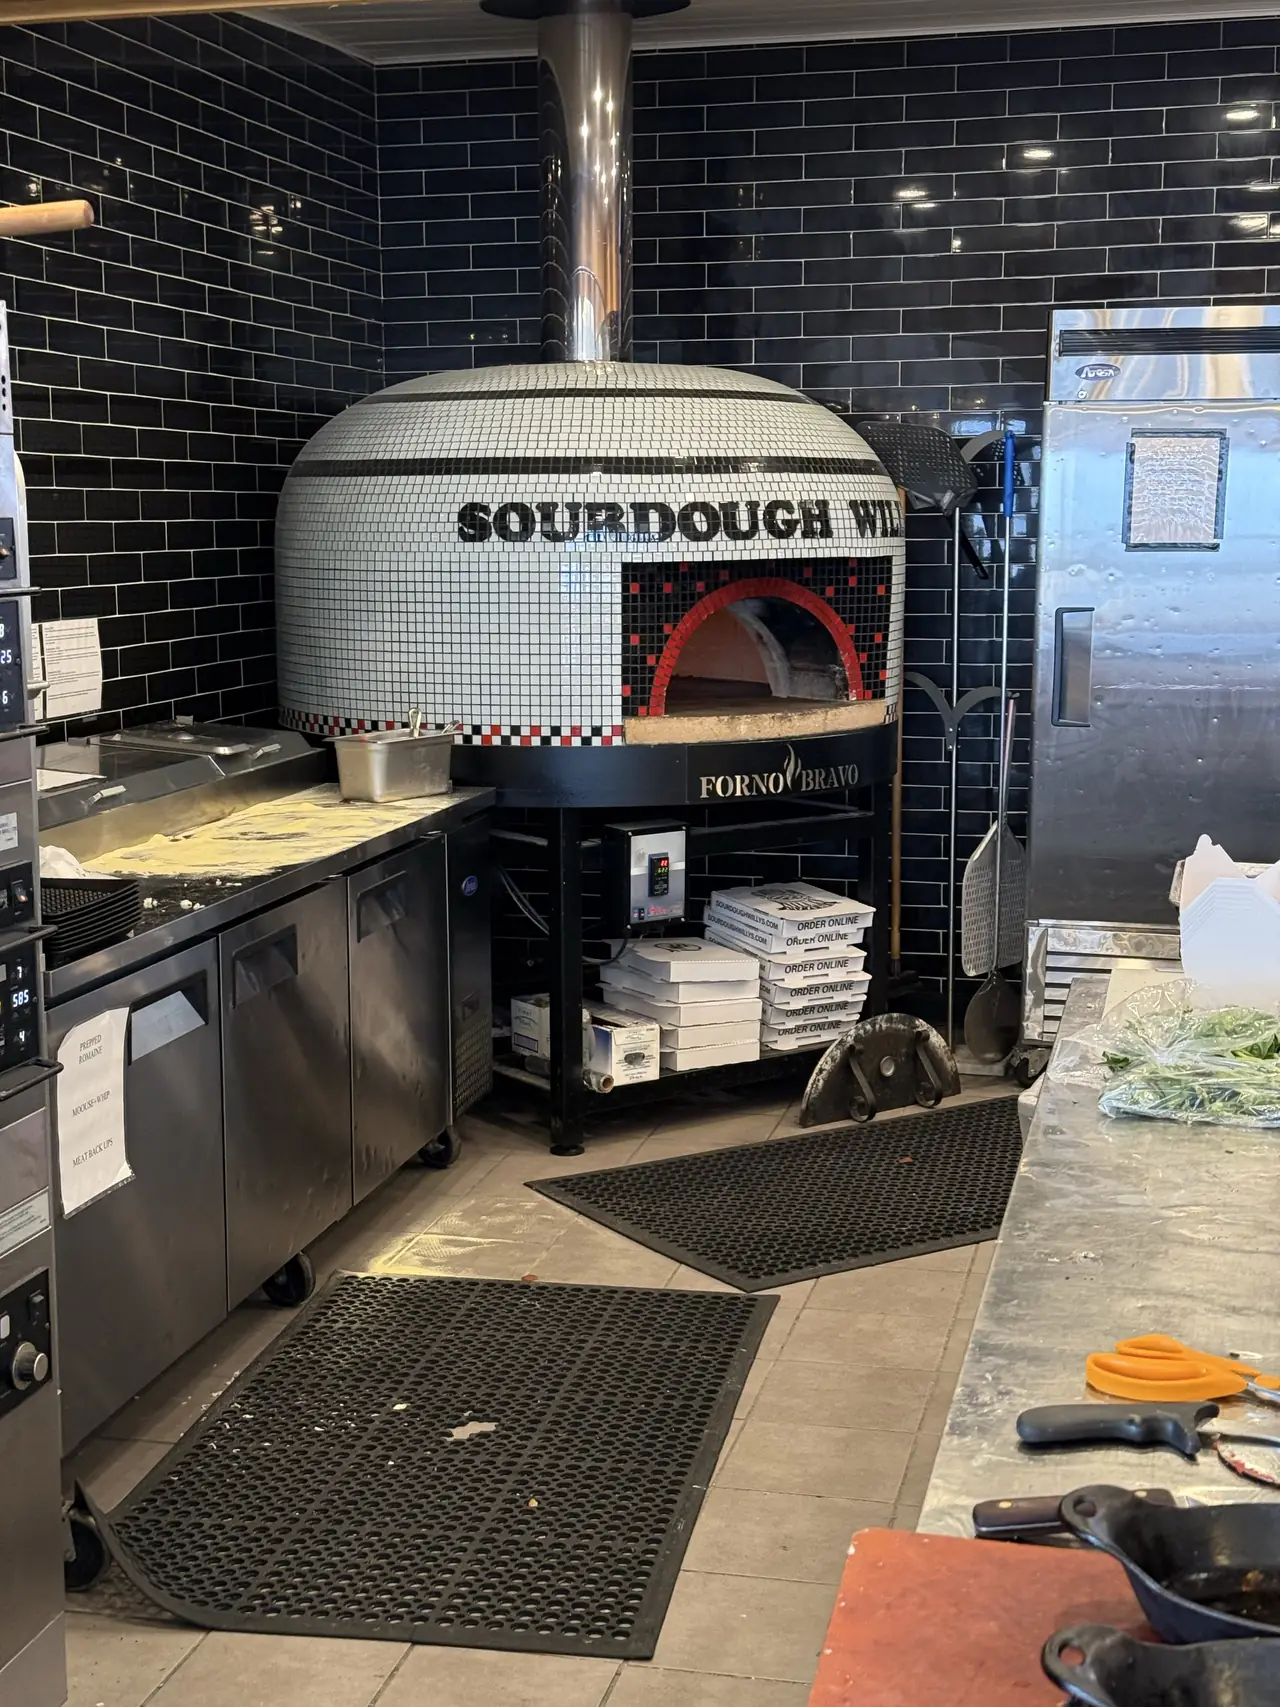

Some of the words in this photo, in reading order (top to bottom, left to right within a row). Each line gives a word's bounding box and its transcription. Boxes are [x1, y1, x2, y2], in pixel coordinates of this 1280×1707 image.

[457, 499, 834, 543] SOURDOUGH
[2, 690, 8, 705] 6
[699, 772, 784, 798] FORNO
[800, 764, 859, 792] BRAVO
[715, 900, 779, 930] SOURDOUGHWILLYS.COM
[797, 917, 826, 931] ORDER
[826, 915, 860, 927] ONLINE
[707, 913, 768, 946] SOURDOUGHWILLYS.COM
[786, 936, 816, 948] ORDER
[817, 932, 849, 943] ONLINE
[784, 963, 815, 974] ORDER
[817, 959, 849, 970] ONLINE
[790, 986, 820, 997] ORDER
[822, 982, 854, 993] ONLINE
[12, 989, 29, 1008] 585
[785, 1006, 815, 1018] ORDER
[817, 1002, 849, 1014] ONLINE
[19, 1030, 25, 1042] 4
[777, 1025, 808, 1036] ORDER
[809, 1021, 841, 1032] ONLINE
[79, 1034, 102, 1052] PREPPED
[78, 1045, 103, 1065] ROMAINE
[72, 1151, 88, 1168] MEAT
[88, 1143, 103, 1159] BACK
[103, 1137, 113, 1150] UPS
